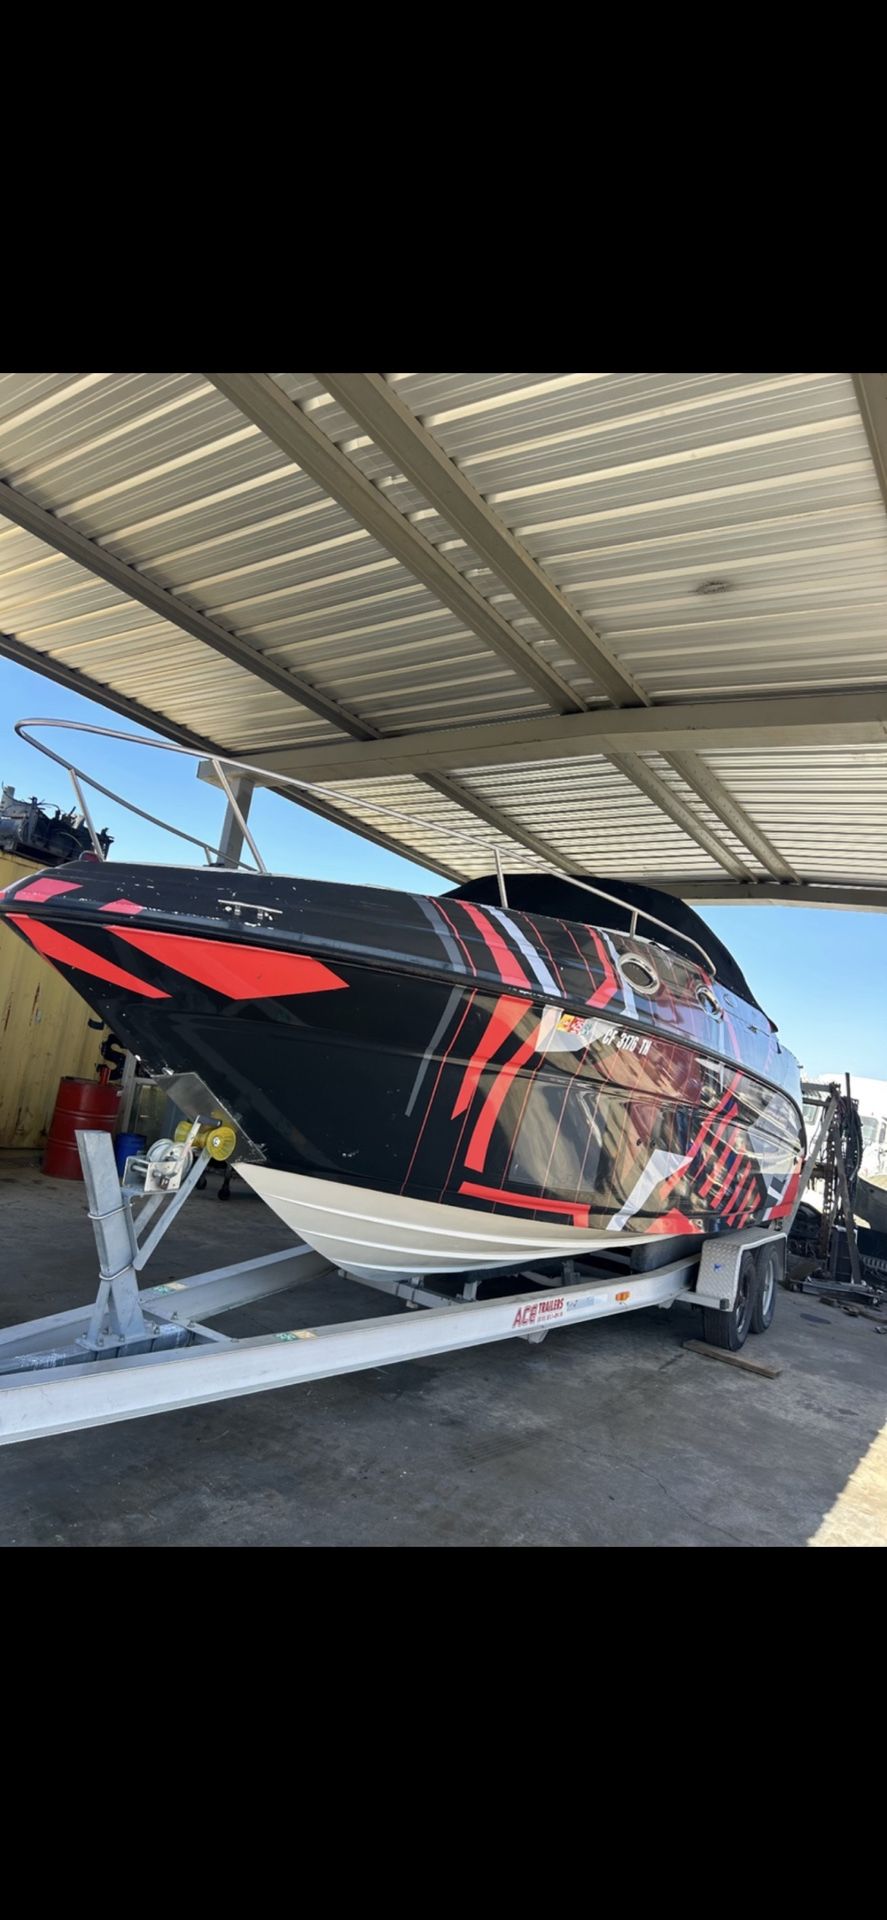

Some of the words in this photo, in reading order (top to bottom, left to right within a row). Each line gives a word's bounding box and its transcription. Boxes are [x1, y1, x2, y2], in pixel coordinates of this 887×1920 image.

[602, 1028, 619, 1045] CF
[616, 1032, 640, 1052] 3176
[538, 1298, 564, 1313] TRAILERS
